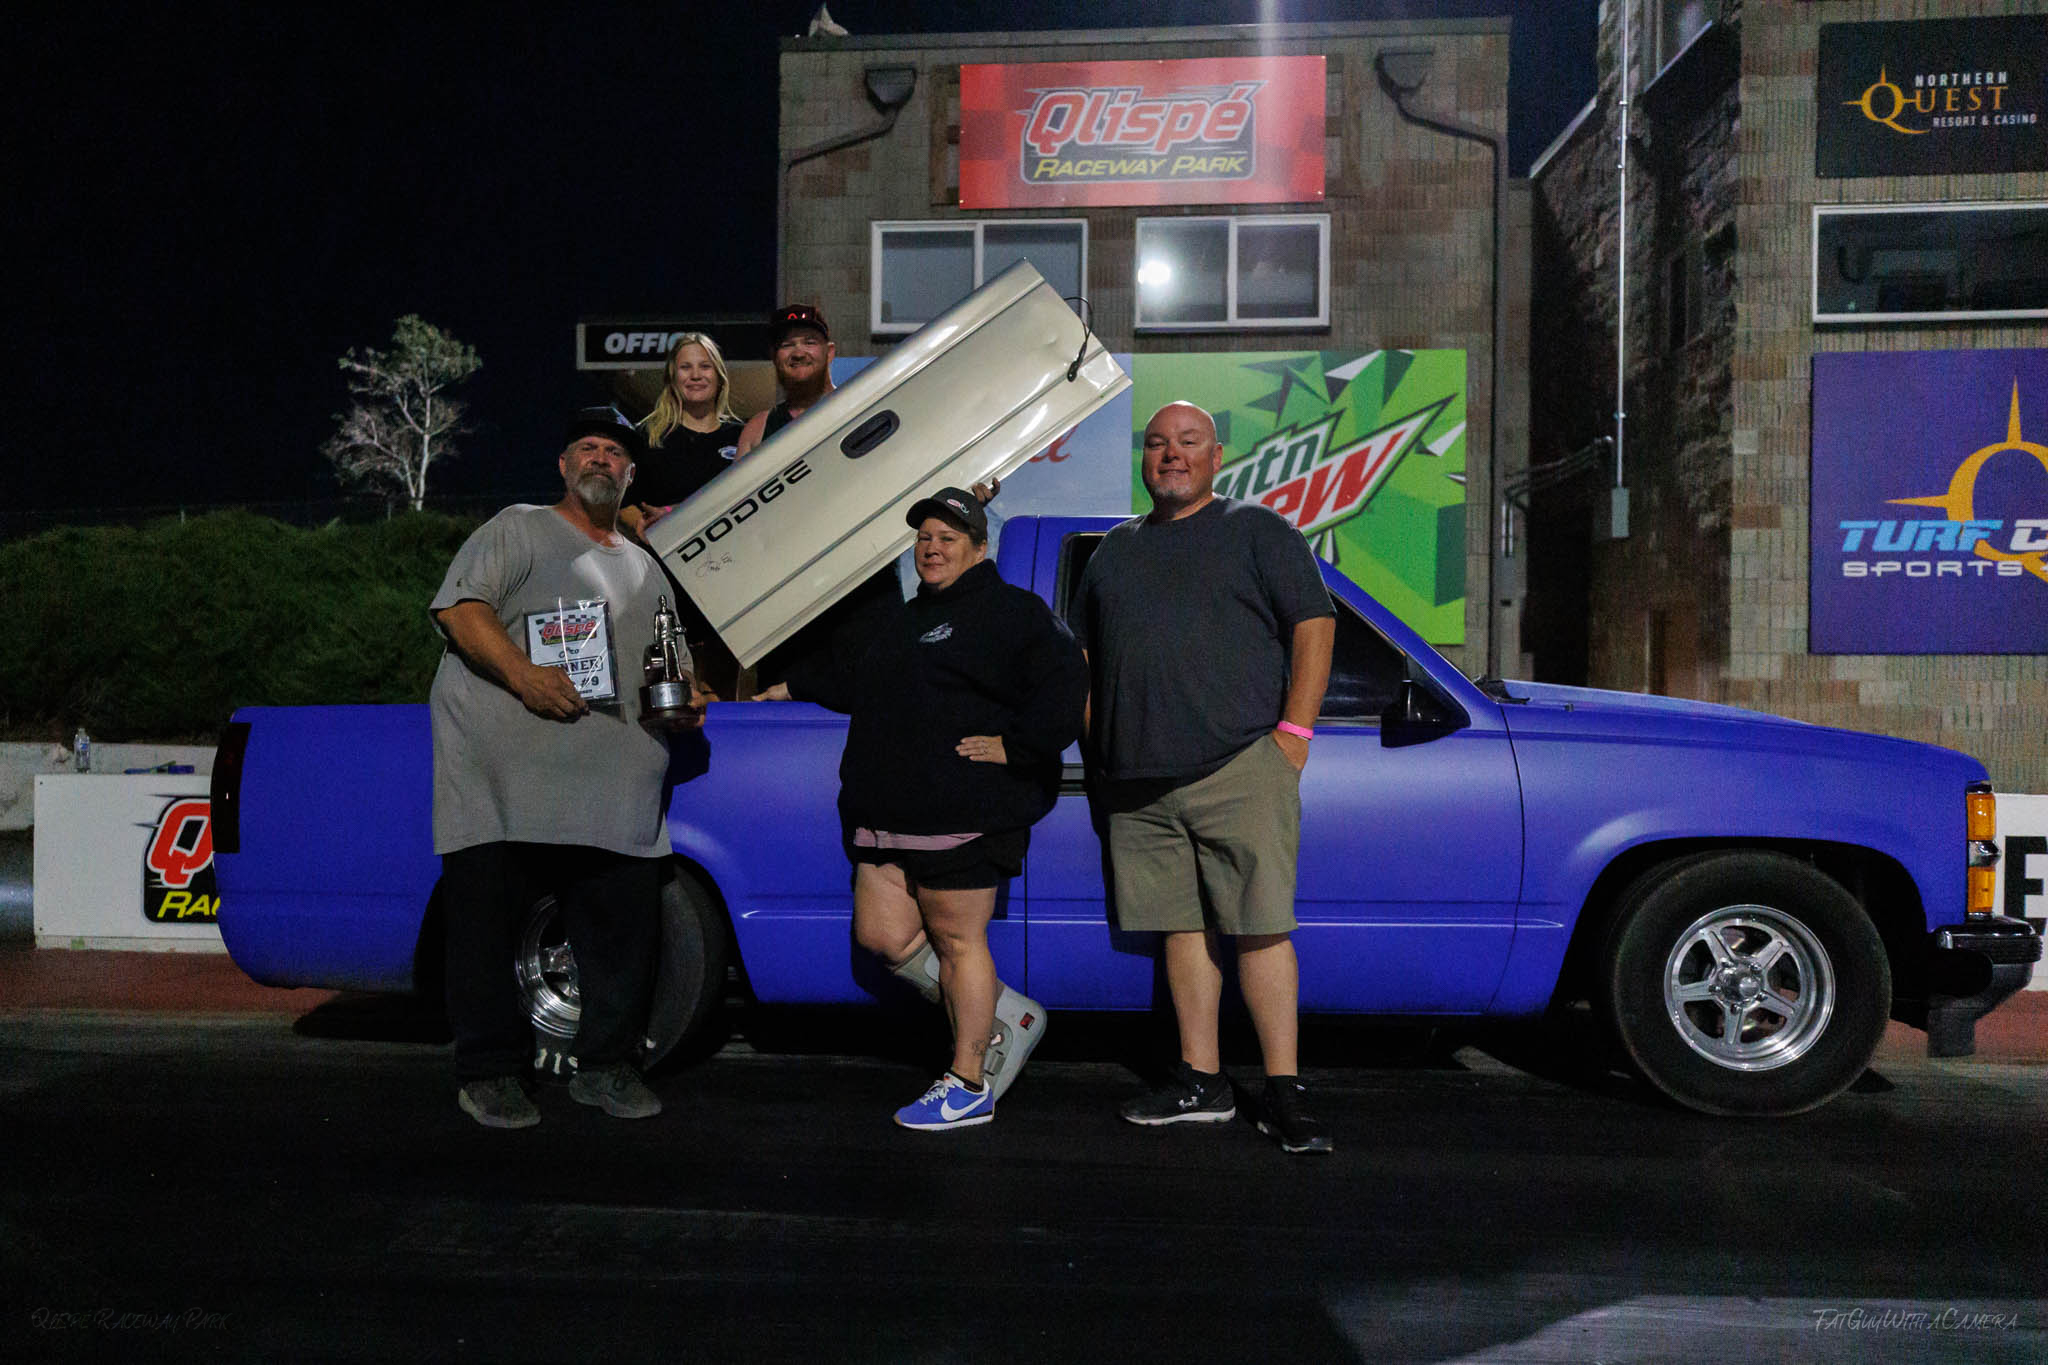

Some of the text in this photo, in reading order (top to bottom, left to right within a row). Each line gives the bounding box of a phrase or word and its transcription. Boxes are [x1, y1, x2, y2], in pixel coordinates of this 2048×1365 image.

[1914, 71, 2008, 88] NORTHERN
[1838, 63, 2009, 134] QUEST
[1026, 81, 1256, 156] Qlispé
[1932, 113, 2038, 128] RESORT & CASINO
[1033, 155, 1249, 179] RACEWAY PARK
[604, 332, 686, 354] OFFIC
[676, 459, 812, 563] DODGE
[1840, 519, 2004, 552] TURF
[1843, 560, 2024, 578] SPORTS
